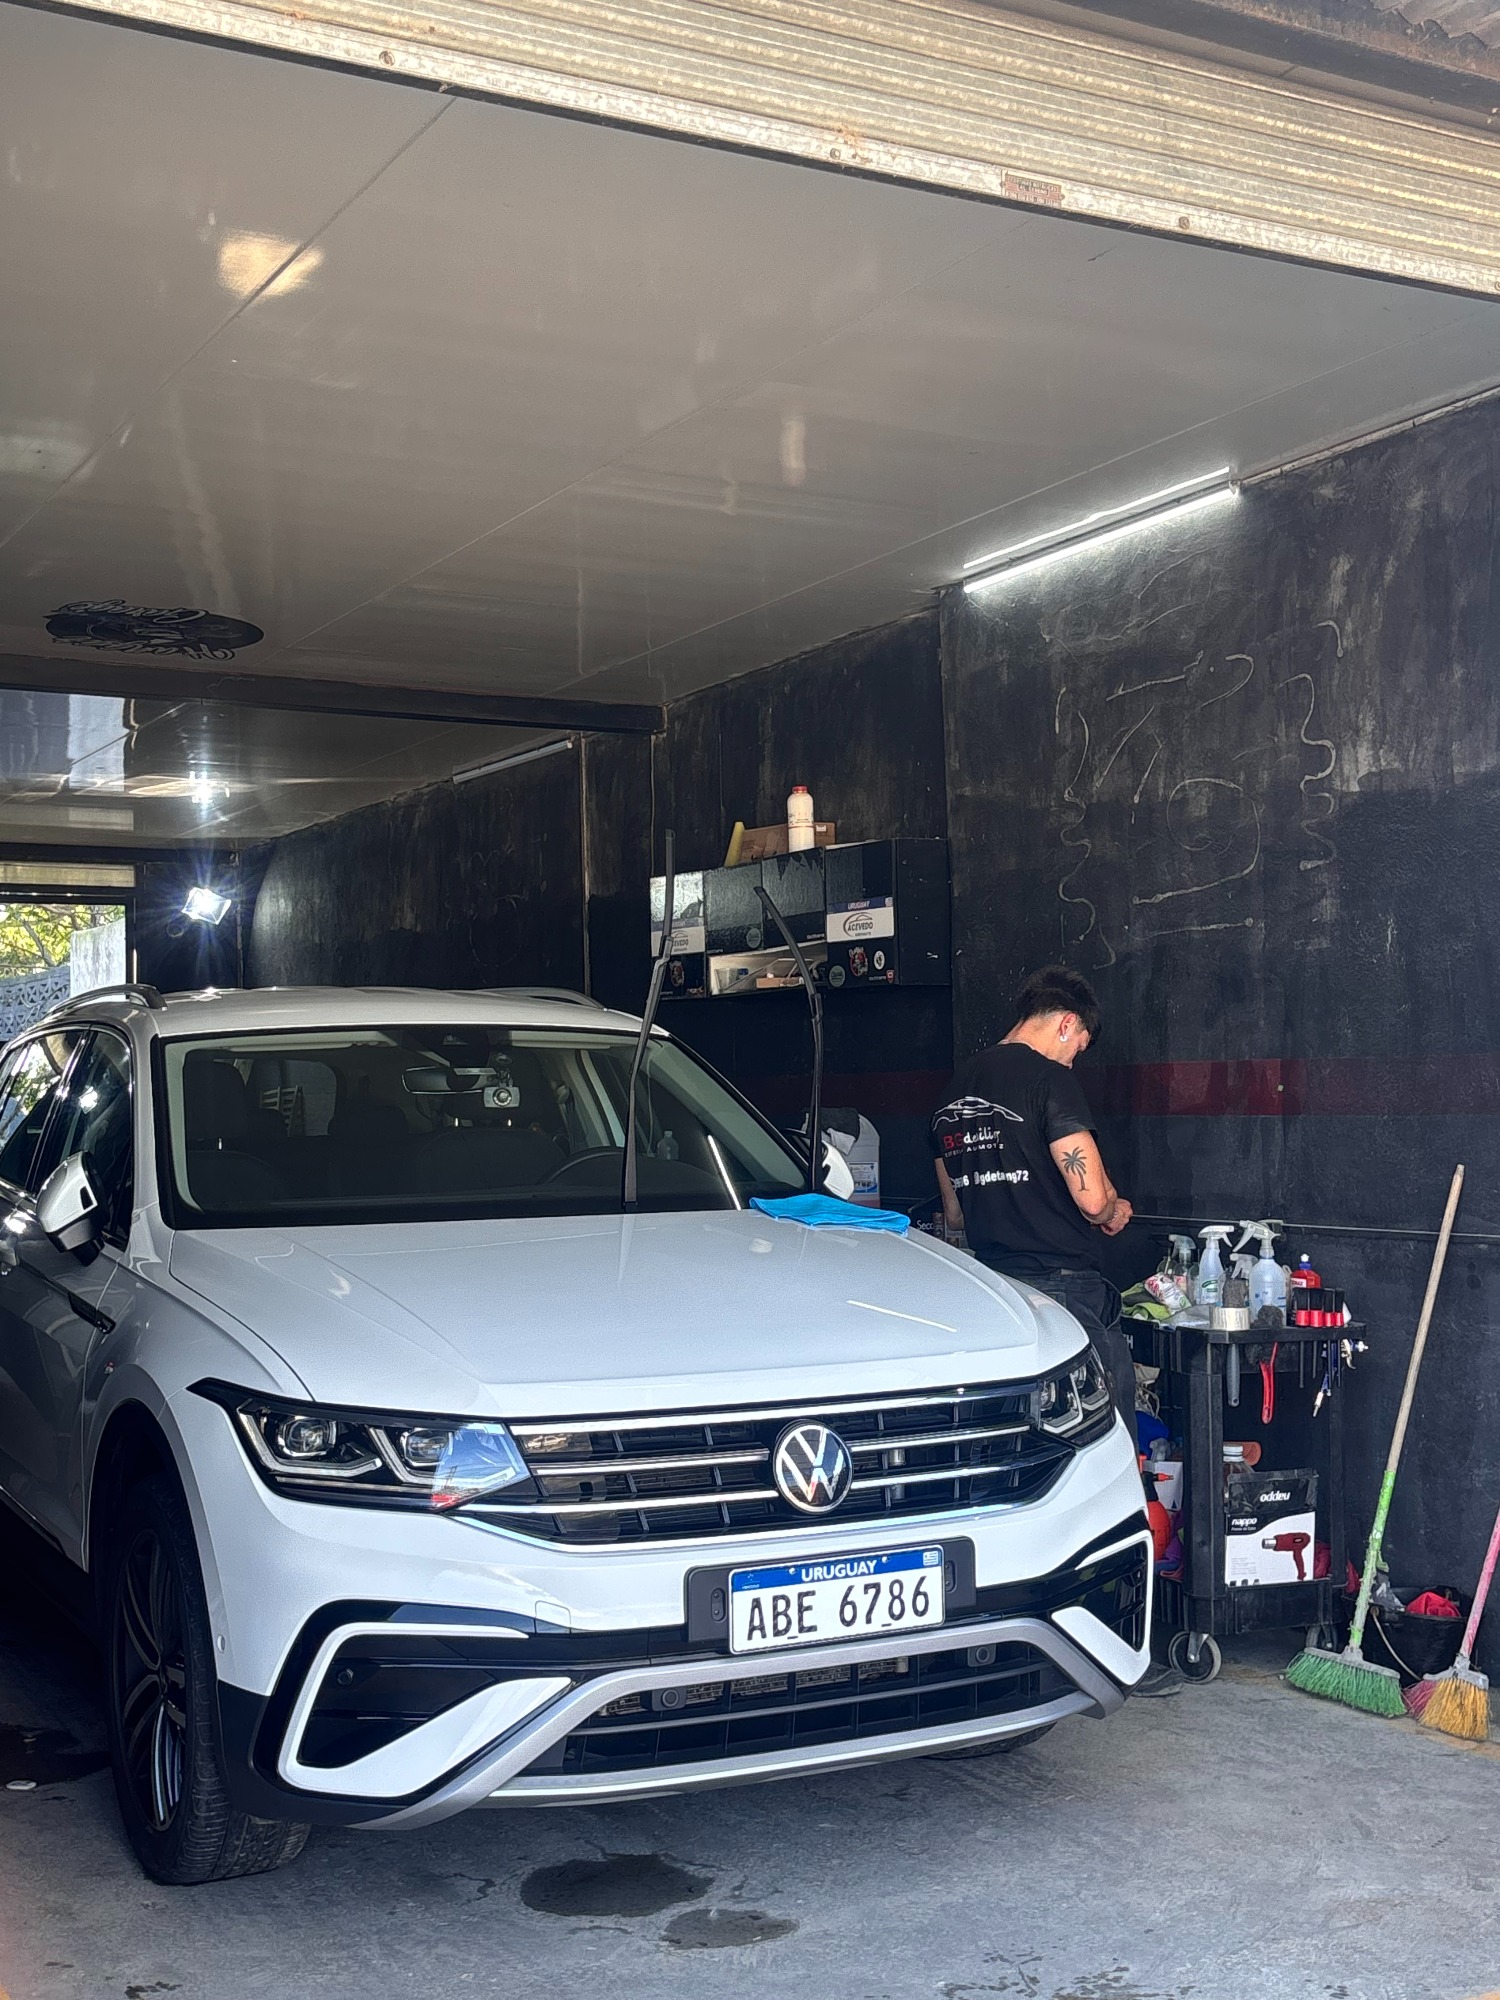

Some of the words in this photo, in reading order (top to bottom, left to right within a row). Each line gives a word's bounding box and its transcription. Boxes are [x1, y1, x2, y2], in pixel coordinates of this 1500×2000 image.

[847, 921, 873, 932] ACEVEDO
[1231, 1518, 1258, 1527] nappo
[800, 1559, 878, 1582] URUGUAY
[747, 1589, 818, 1641] ABE
[839, 1575, 930, 1628] 6786
